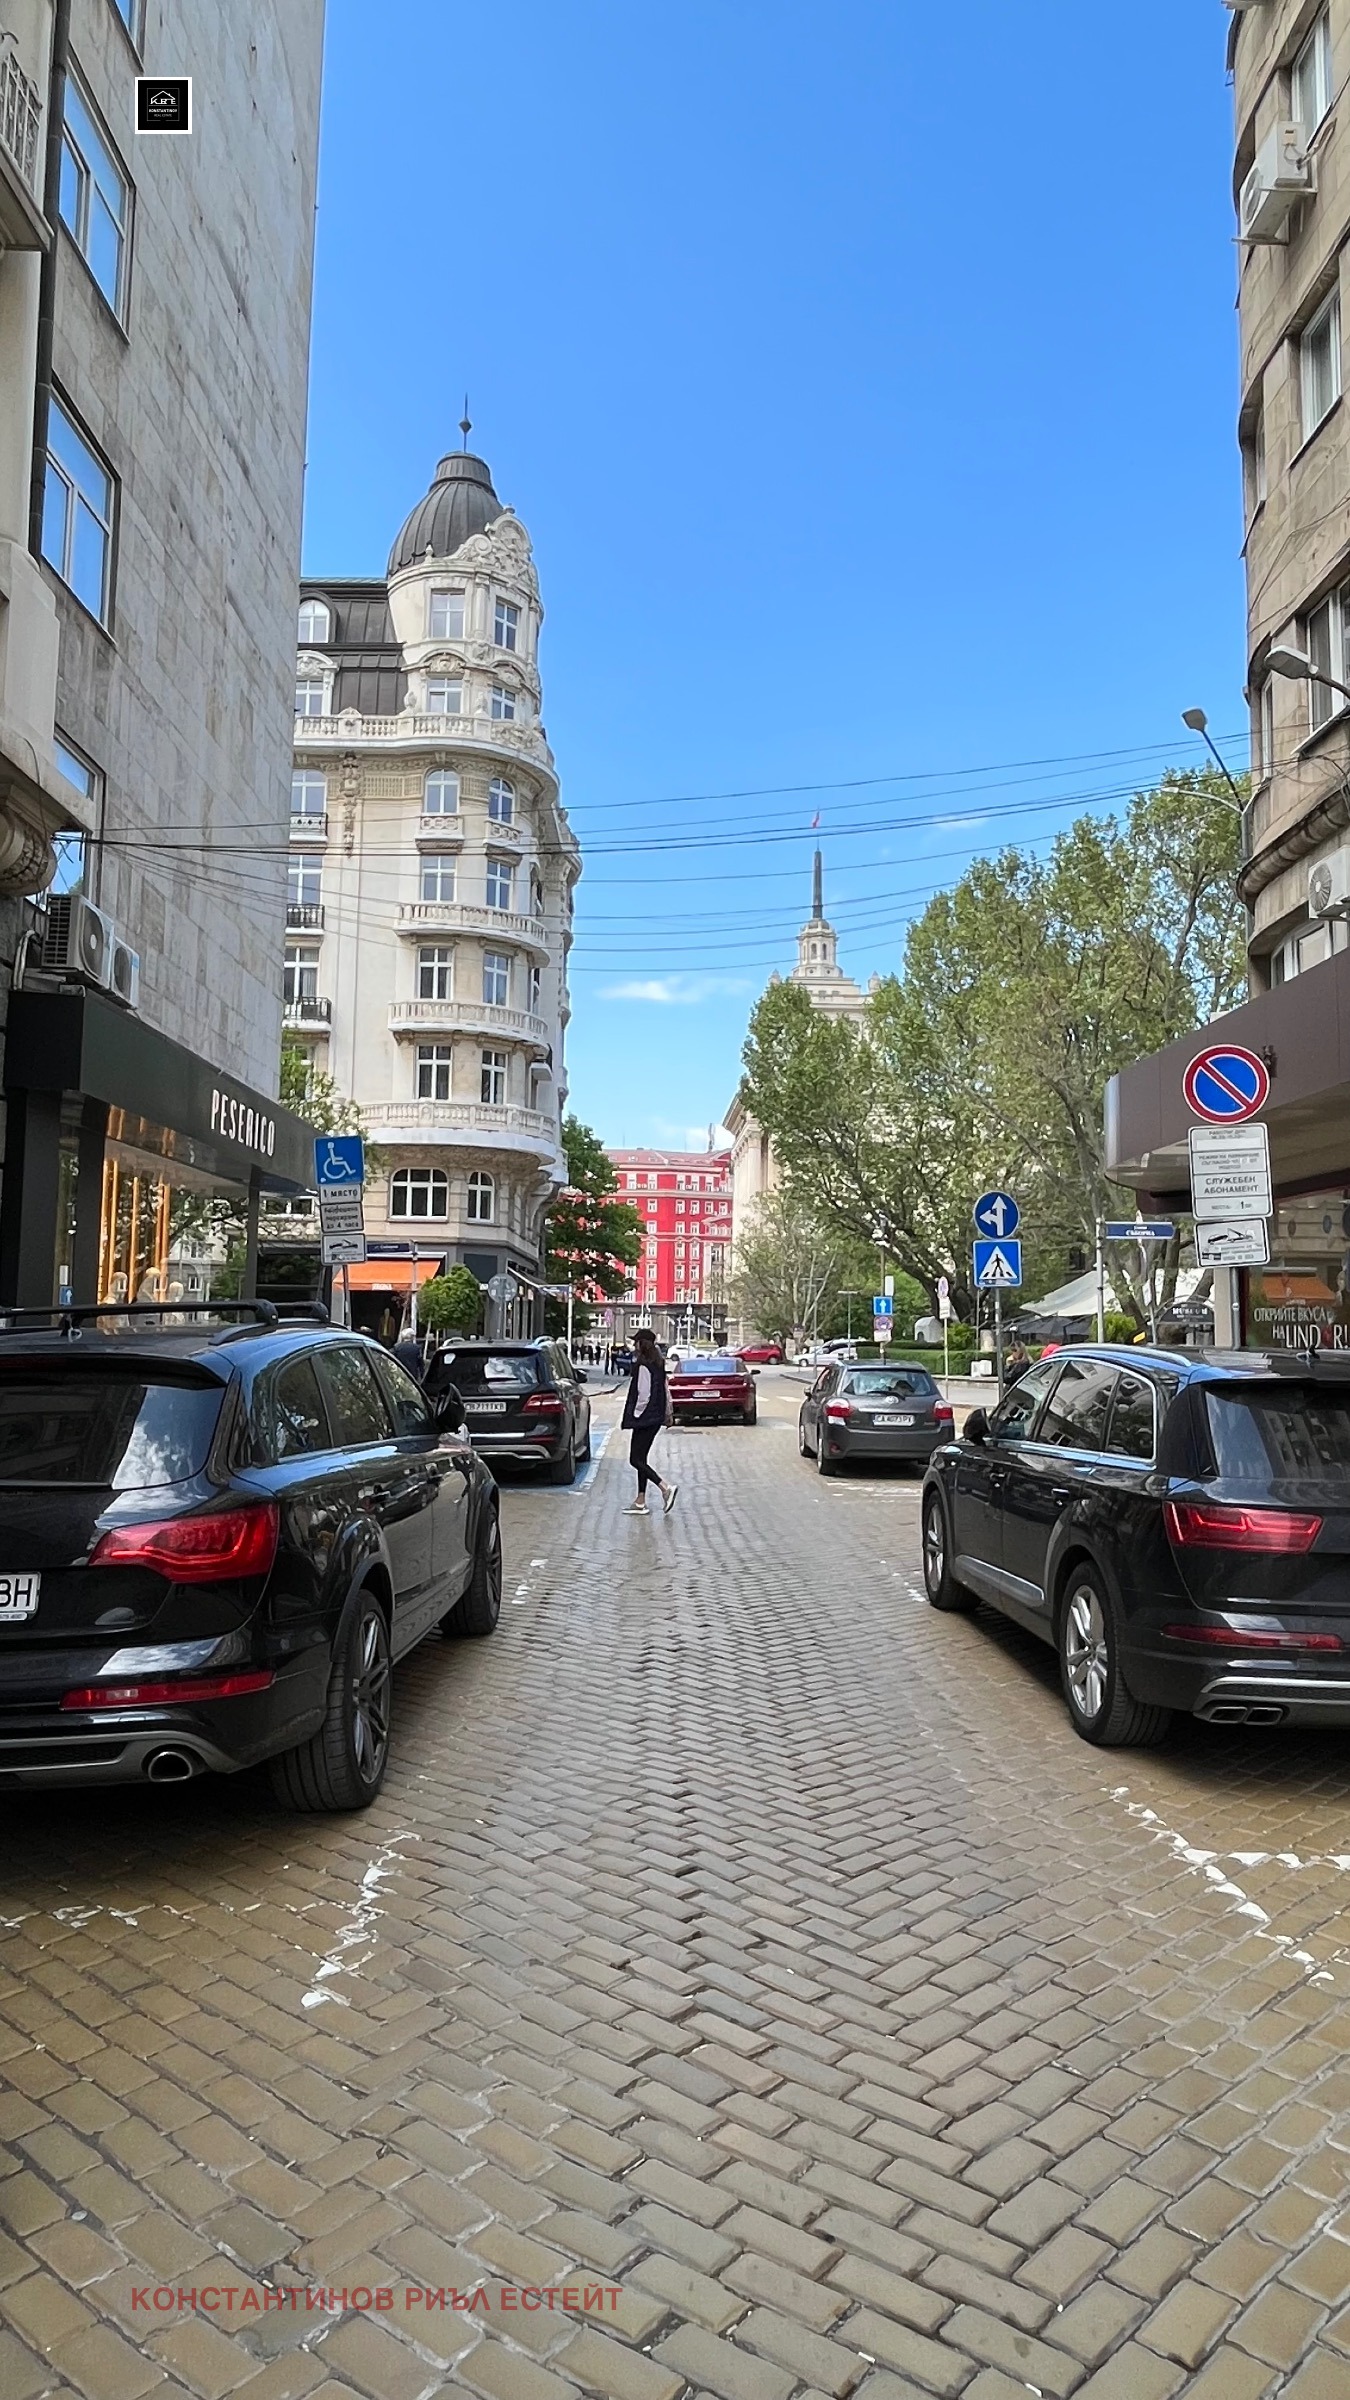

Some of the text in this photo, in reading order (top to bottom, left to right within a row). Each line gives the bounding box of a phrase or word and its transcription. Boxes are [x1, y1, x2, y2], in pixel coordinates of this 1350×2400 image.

[210, 1089, 276, 1157] PESERICO
[1205, 1176, 1256, 1185] СЛУЖЕБЕН
[1204, 1185, 1259, 1194] АБОНАМЕНТ
[1297, 1305, 1327, 1321] ВКУСА
[1272, 1324, 1286, 1340] НА
